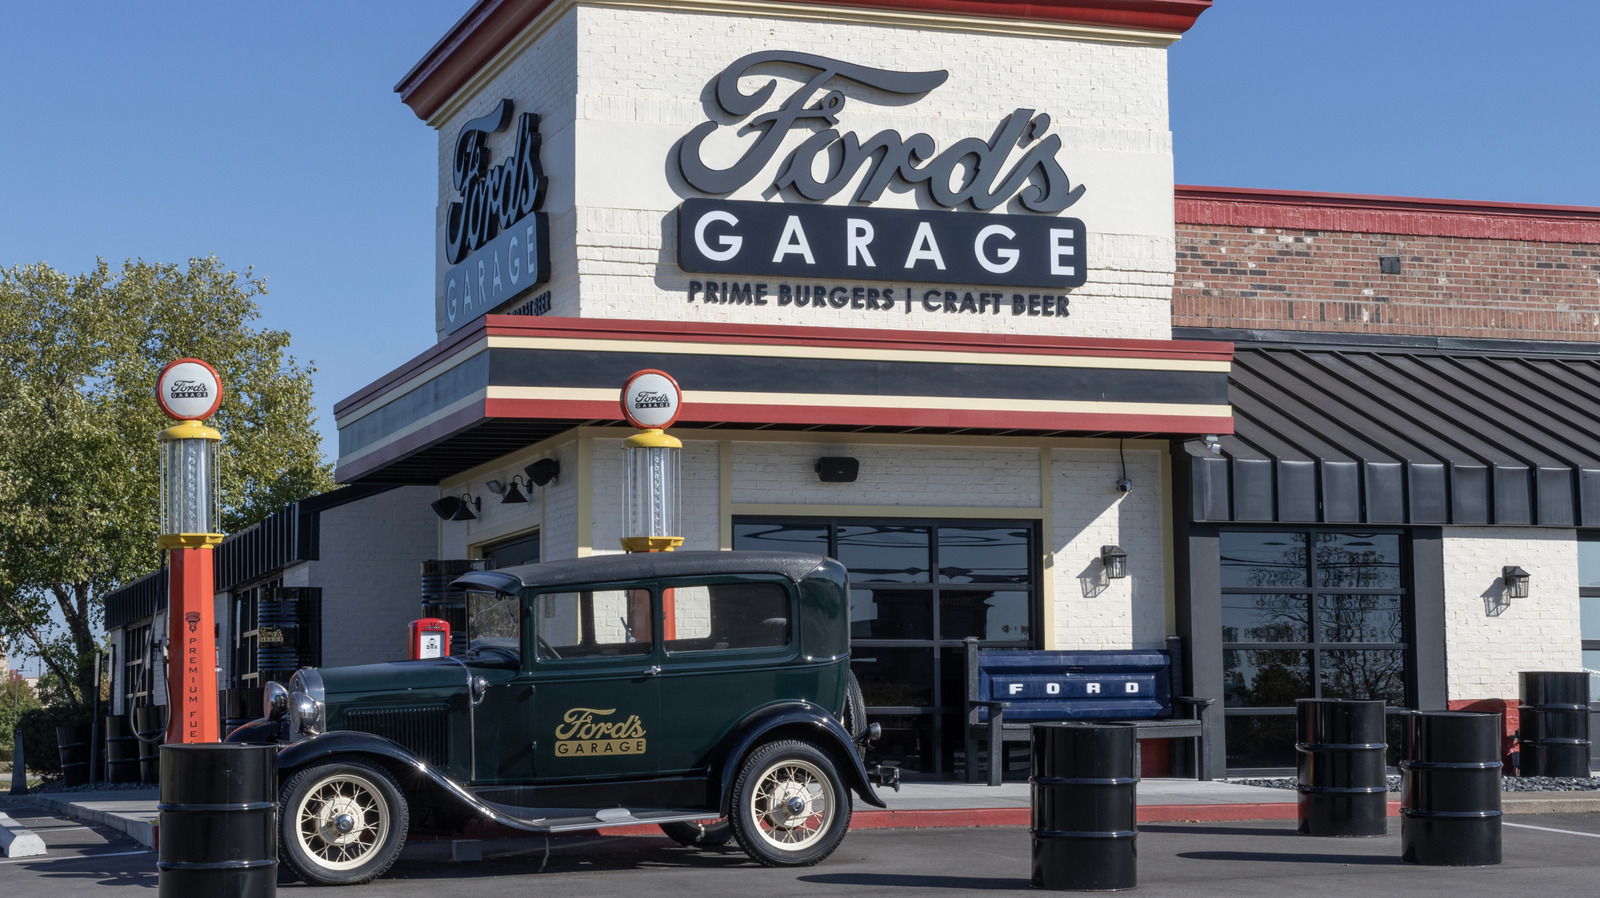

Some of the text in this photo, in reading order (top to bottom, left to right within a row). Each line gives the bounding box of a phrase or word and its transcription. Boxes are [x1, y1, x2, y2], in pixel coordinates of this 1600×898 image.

[678, 50, 1087, 214] Ford's
[694, 210, 1076, 276] GARAGE
[446, 225, 536, 324] GARAGE
[688, 280, 768, 306] PRIME
[778, 284, 895, 311] BURGERS
[923, 289, 1003, 314] CRAFT
[1012, 293, 1070, 317] BEER
[170, 380, 207, 392] Ford's
[635, 391, 669, 402] Ford's
[189, 638, 198, 703] PREMIUM
[1009, 682, 1139, 695] FORD
[190, 711, 198, 744] FUE
[555, 707, 647, 740] Ford's
[558, 741, 643, 754] GARAGE
